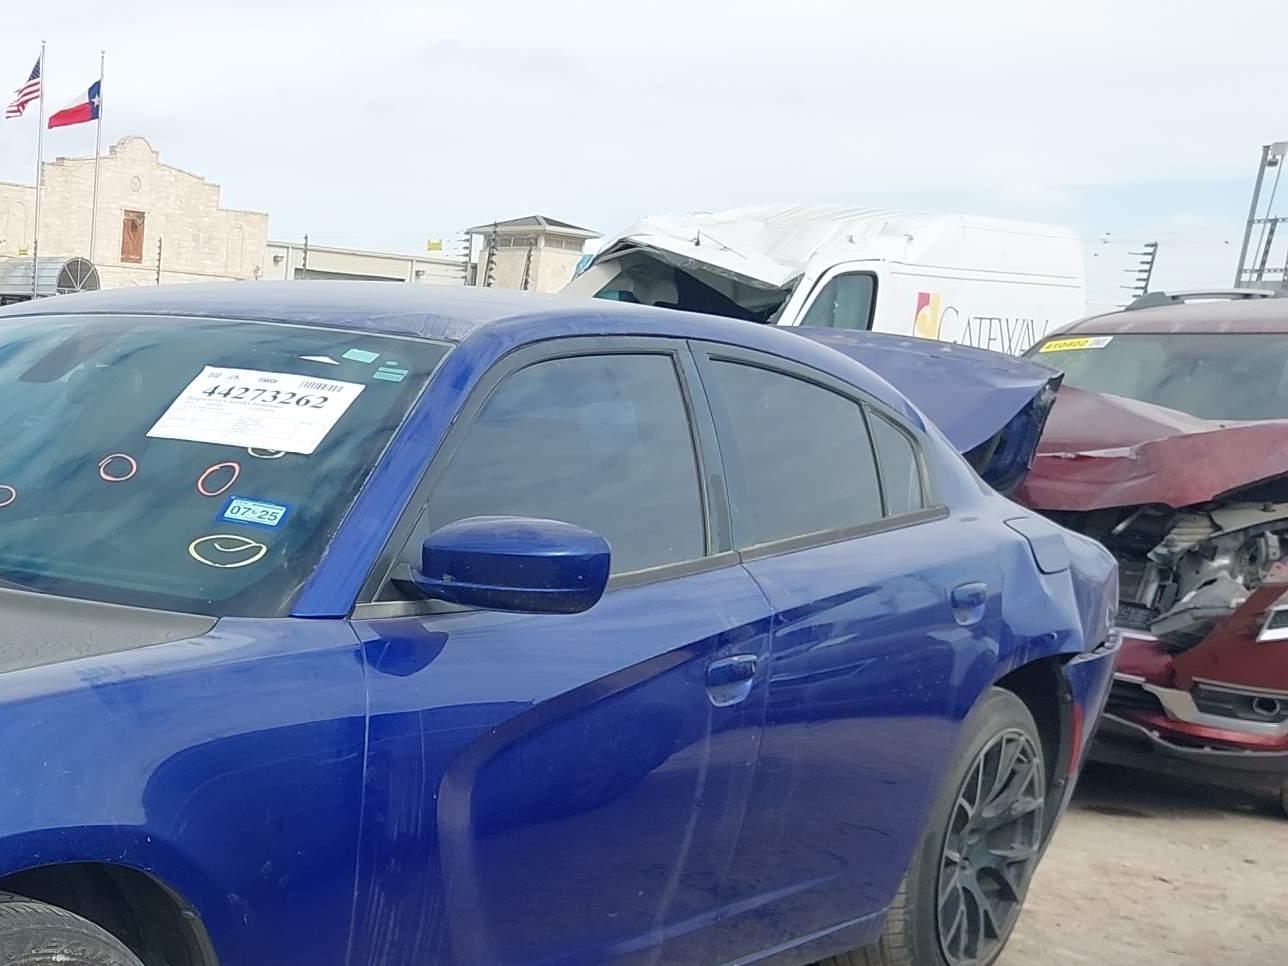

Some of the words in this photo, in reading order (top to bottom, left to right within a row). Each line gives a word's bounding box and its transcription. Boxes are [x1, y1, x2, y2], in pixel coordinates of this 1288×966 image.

[202, 384, 329, 409] 44273262
[230, 505, 252, 516] 07
[257, 510, 279, 521] 25
